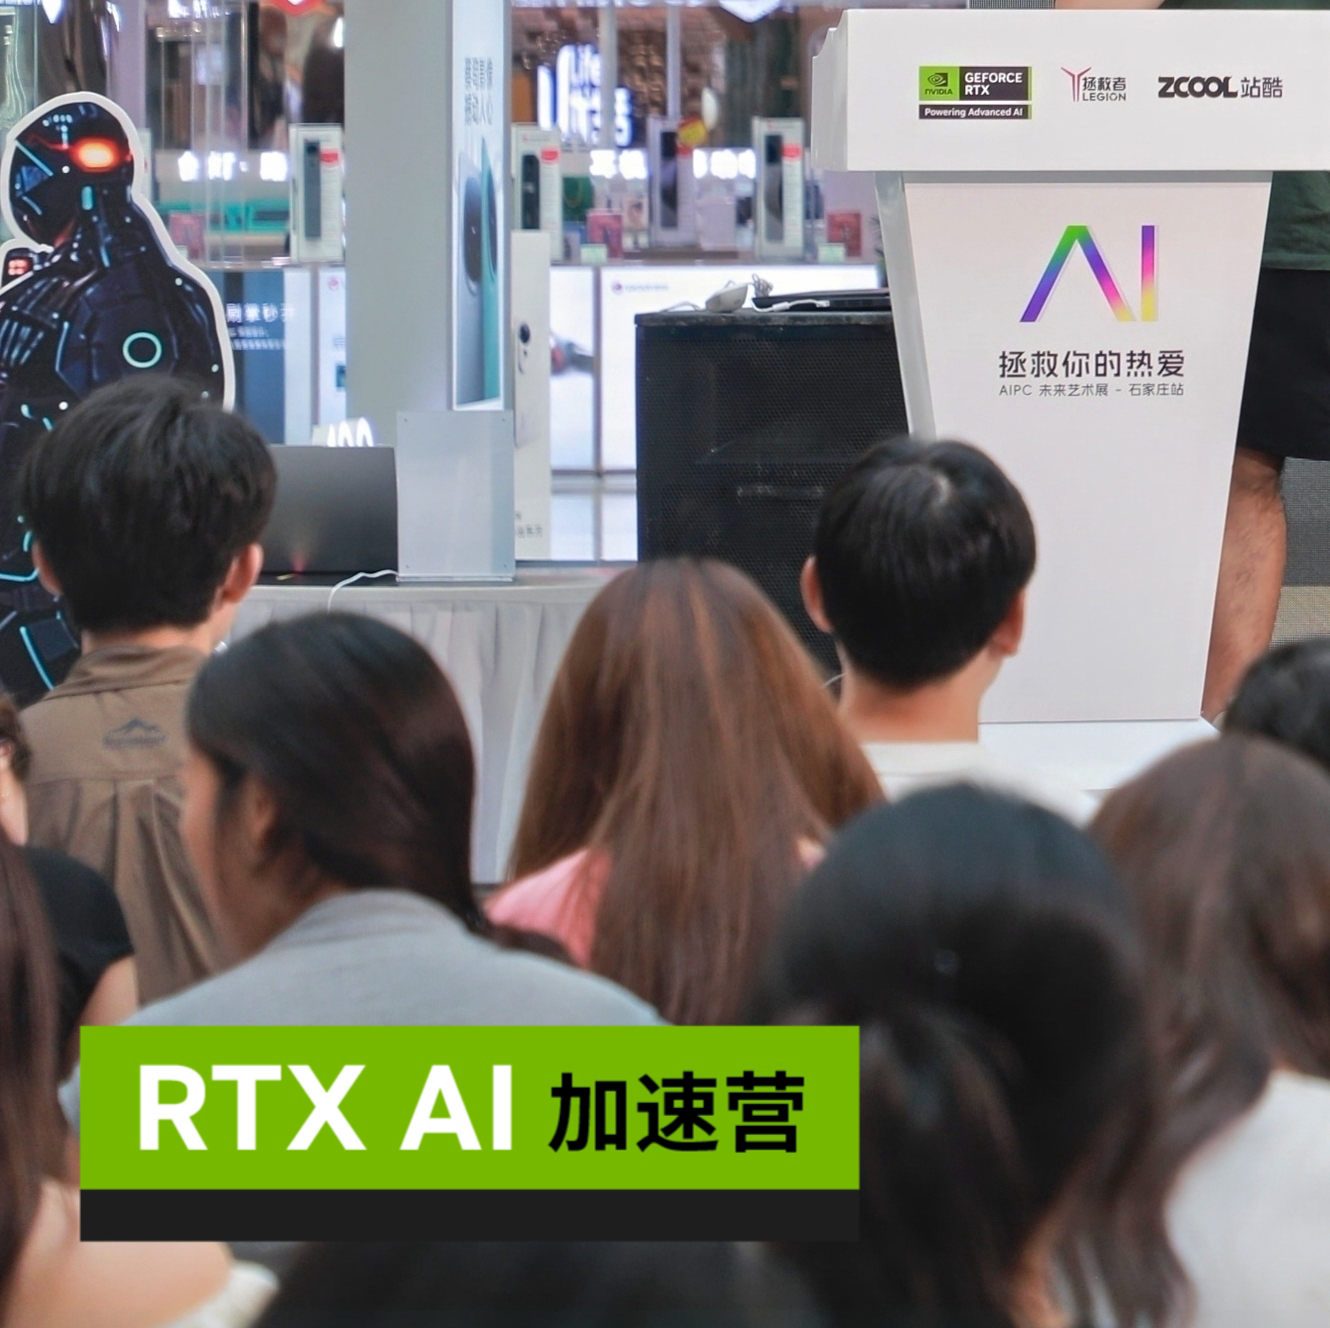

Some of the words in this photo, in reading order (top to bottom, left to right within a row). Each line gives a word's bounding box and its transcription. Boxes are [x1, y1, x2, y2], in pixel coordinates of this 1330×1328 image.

[964, 72, 1023, 84] GEFORCE
[1082, 77, 1126, 91] 拯救者
[925, 88, 953, 96] NVIDIA
[964, 85, 989, 96] RTX
[1158, 76, 1238, 98] ZCOOL
[1240, 77, 1283, 98] 站酷
[1082, 93, 1126, 102] LEGION
[924, 108, 966, 118] Powering
[968, 107, 1013, 116] Advanced
[1014, 107, 1023, 116] AI
[1020, 225, 1159, 322] AI
[999, 350, 1185, 378] 拯救你的热爱
[999, 384, 1032, 396] AIPC
[1039, 383, 1109, 397] 未来艺术展
[1129, 383, 1184, 396] 石家庄站
